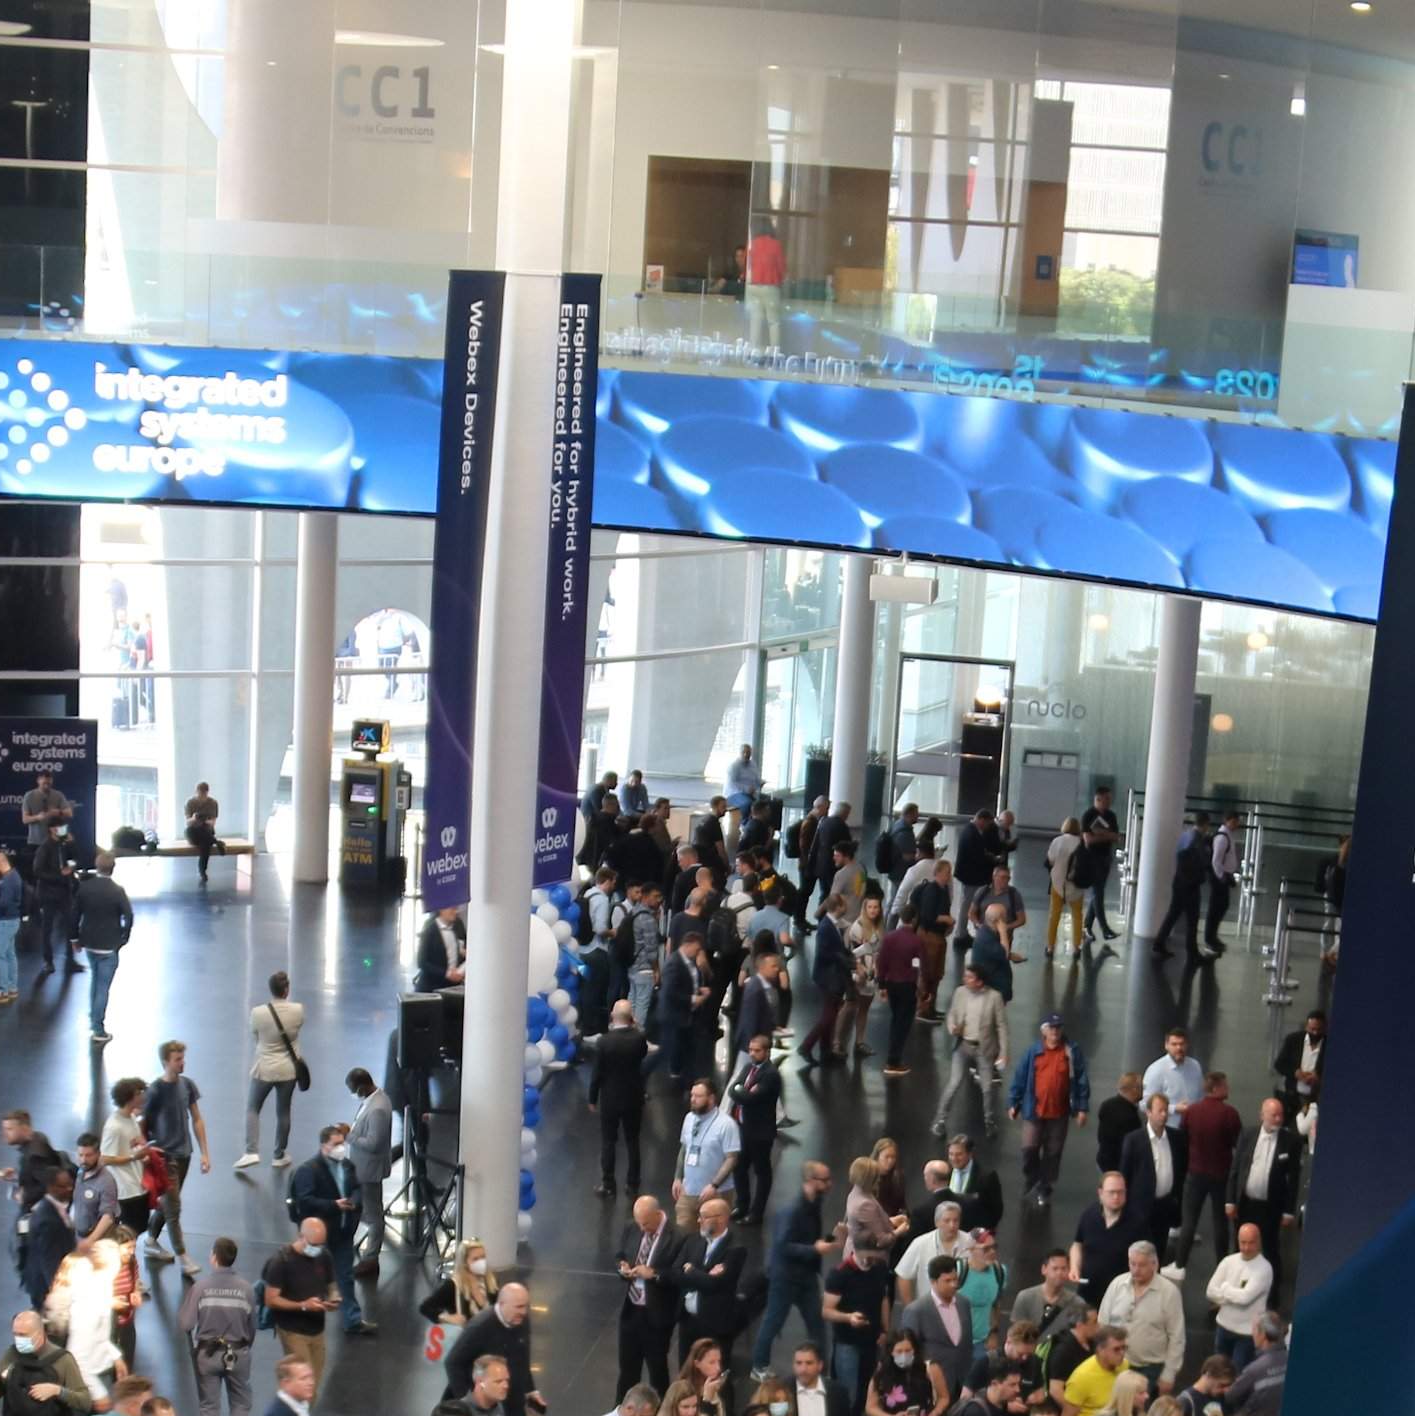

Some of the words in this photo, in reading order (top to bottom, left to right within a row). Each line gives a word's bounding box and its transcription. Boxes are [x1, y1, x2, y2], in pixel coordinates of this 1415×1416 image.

[466, 300, 484, 385] Webex
[94, 361, 288, 408] integrated
[555, 303, 573, 436] Engineered
[571, 303, 588, 435] Engineered
[139, 408, 287, 444] systems
[460, 393, 478, 495] Devices.
[92, 444, 226, 481] europe
[553, 442, 567, 475] for
[569, 441, 582, 474] for
[550, 479, 562, 529] you.
[565, 479, 581, 551] hybrid
[560, 560, 574, 621] work.
[11, 731, 87, 747] integrated
[29, 747, 87, 761] systems
[11, 761, 63, 773] europe
[343, 853, 373, 865] ATM
[426, 851, 468, 876] webex
